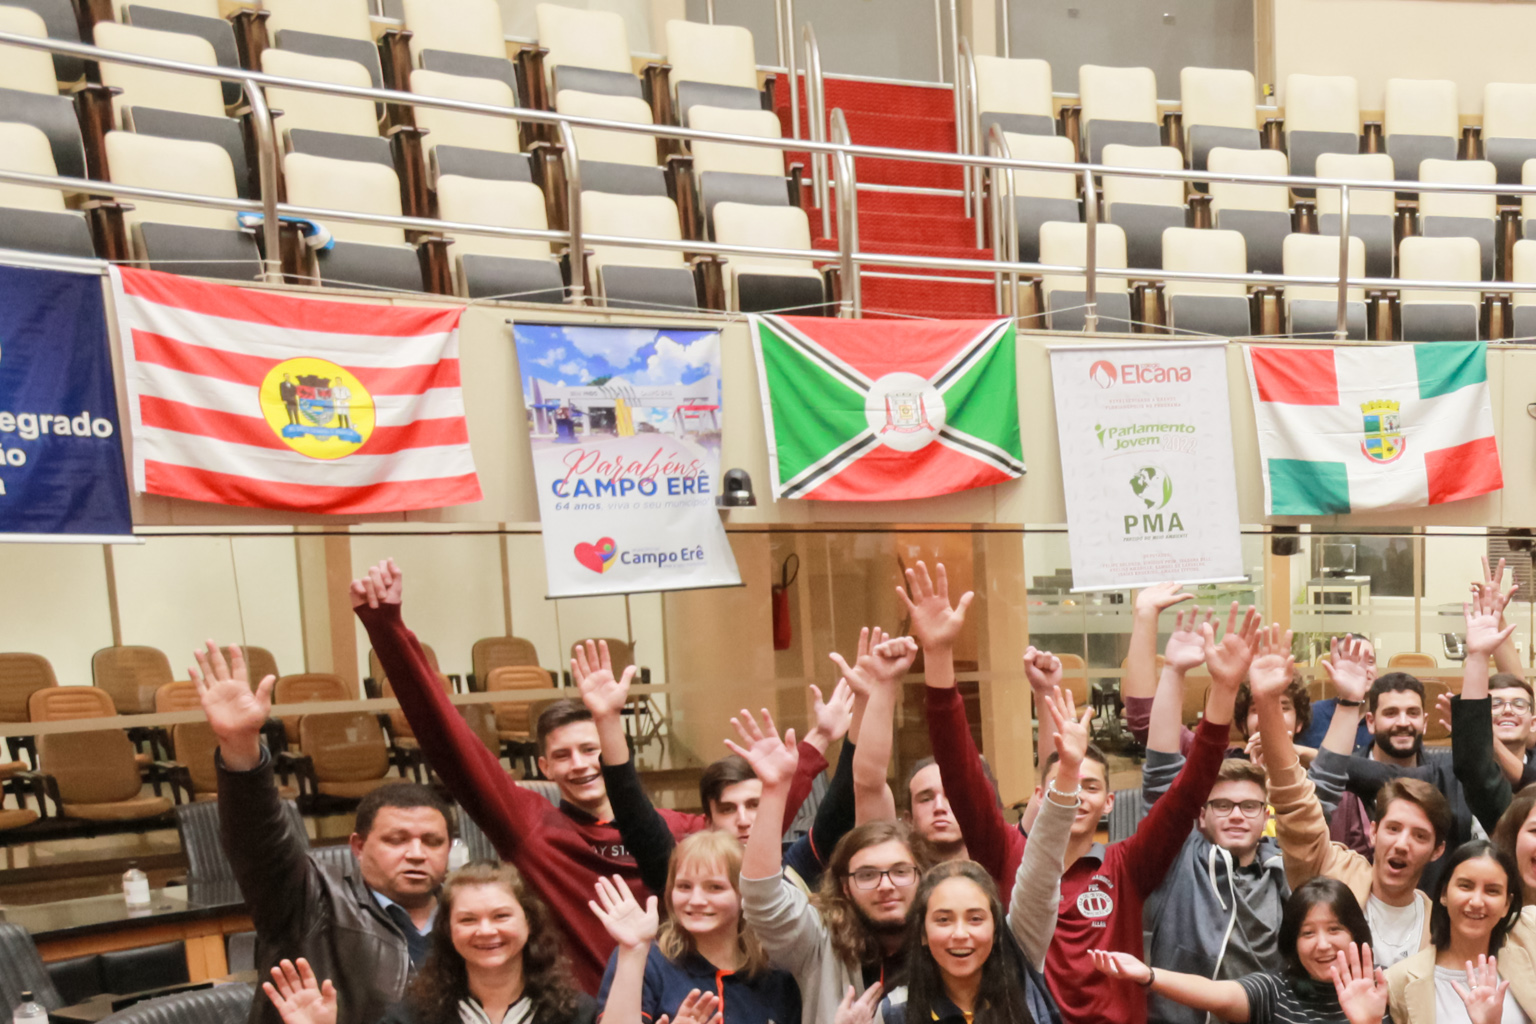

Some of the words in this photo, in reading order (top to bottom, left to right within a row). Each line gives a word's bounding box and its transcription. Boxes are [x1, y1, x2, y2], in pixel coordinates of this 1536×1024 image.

[1121, 364, 1191, 384] Elcana
[1108, 422, 1196, 439] Parlamento
[1113, 435, 1160, 451] Jovem
[563, 447, 704, 496] Parabéns
[552, 478, 658, 498] CAMPO
[667, 470, 711, 496] ERÊ
[555, 502, 570, 511] 64
[1124, 512, 1185, 535] PMA
[621, 551, 678, 568] Campo
[681, 545, 704, 561] Erê
